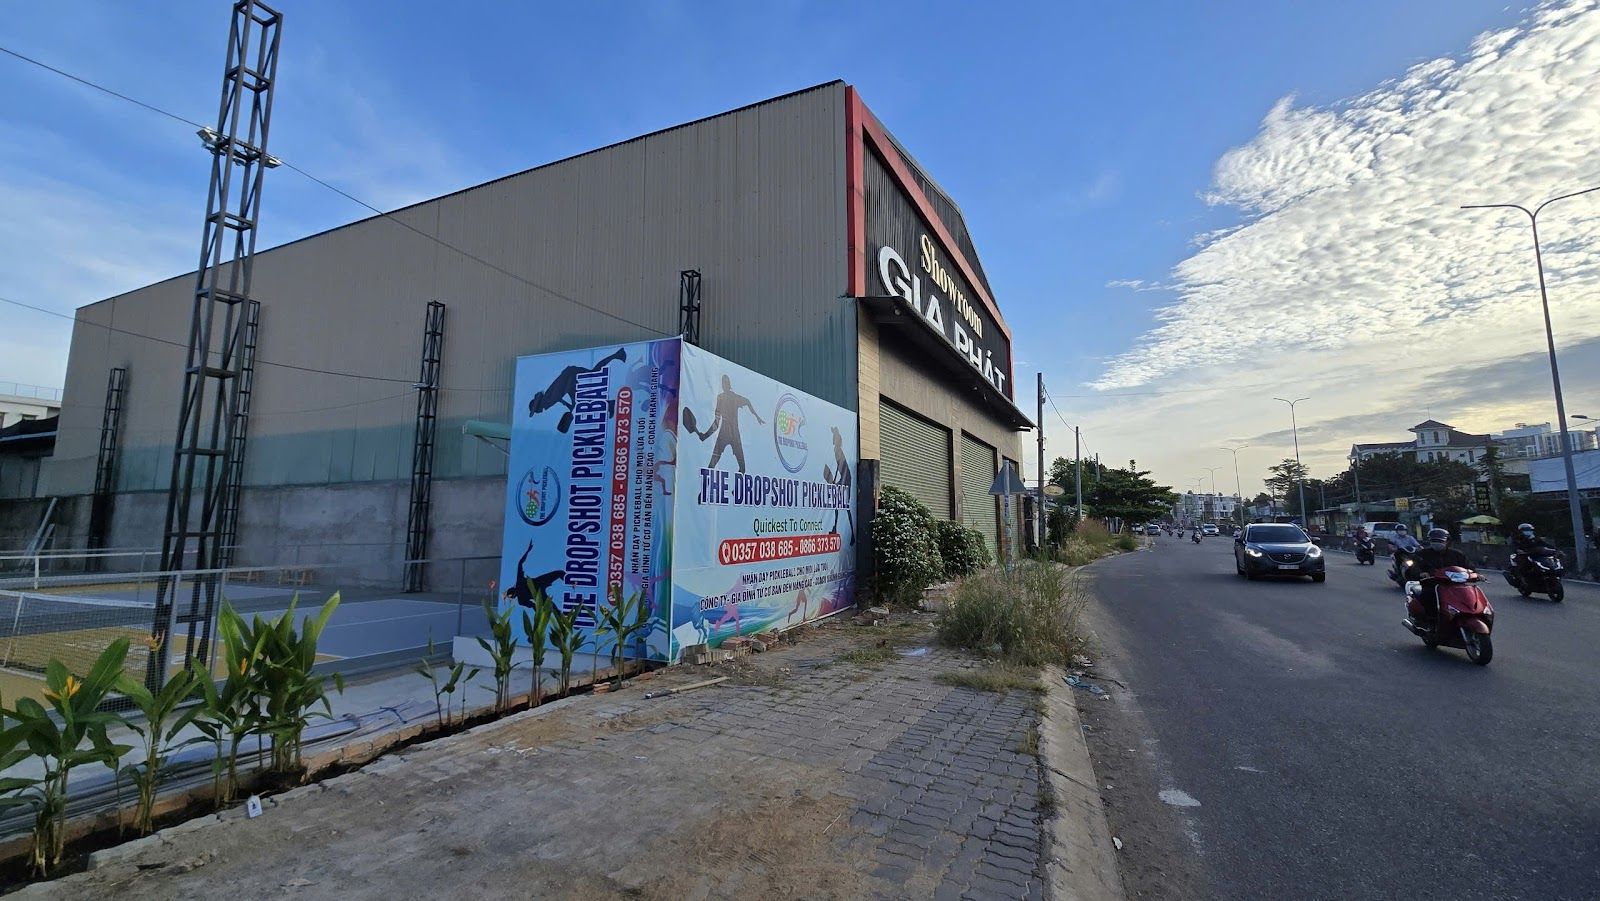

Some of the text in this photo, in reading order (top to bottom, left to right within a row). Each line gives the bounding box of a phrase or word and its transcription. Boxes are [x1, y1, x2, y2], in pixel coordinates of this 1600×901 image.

[921, 234, 983, 338] Showroom
[879, 246, 1005, 395] GIA PHÁT
[619, 390, 631, 414] 570
[571, 367, 609, 478] PICKLEBALL
[617, 419, 629, 443] 373
[648, 419, 656, 444] COACH
[614, 447, 628, 480] 0866
[646, 452, 655, 467] CAO
[635, 469, 643, 485] CHO
[700, 468, 850, 509] THE DROPSHOT PICKLEBALL
[613, 494, 626, 519] 685
[633, 488, 642, 532] PICKLEBALL
[564, 484, 603, 587] DROPSHOT
[611, 524, 625, 549] 038
[753, 518, 823, 536] Quickest To Connect
[632, 534, 642, 550] DẠY
[732, 542, 757, 561] 0357
[760, 540, 776, 559] 038
[778, 539, 793, 557] 685
[799, 538, 816, 554] 0866
[817, 536, 829, 552] 373
[829, 536, 840, 551] 570
[641, 576, 649, 589] GIA
[731, 592, 742, 604] GIA
